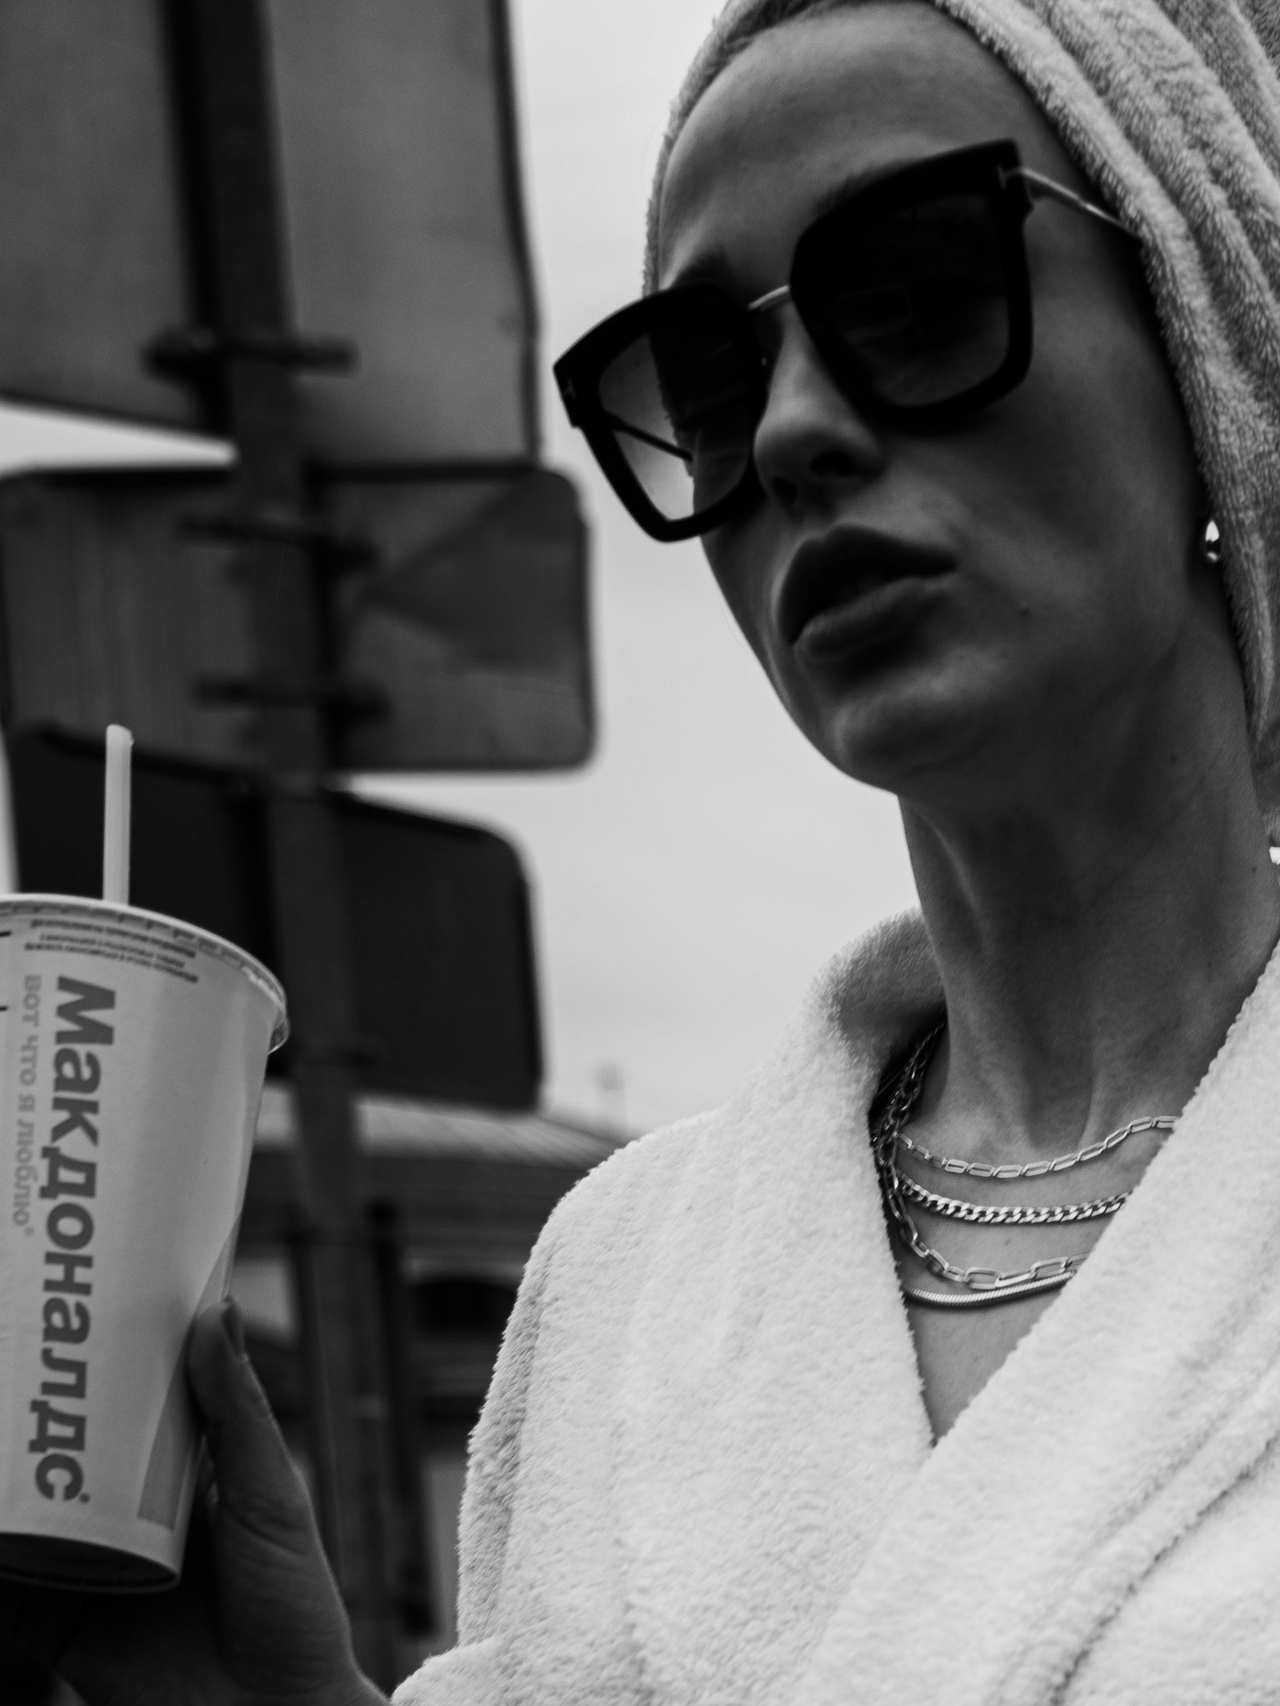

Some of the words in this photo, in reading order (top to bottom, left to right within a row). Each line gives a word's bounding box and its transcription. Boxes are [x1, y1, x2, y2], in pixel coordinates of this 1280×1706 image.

[22, 975, 42, 1027] вот
[20, 1034, 40, 1087] что
[18, 1093, 37, 1113] я
[27, 975, 116, 1502] Макдоналдс
